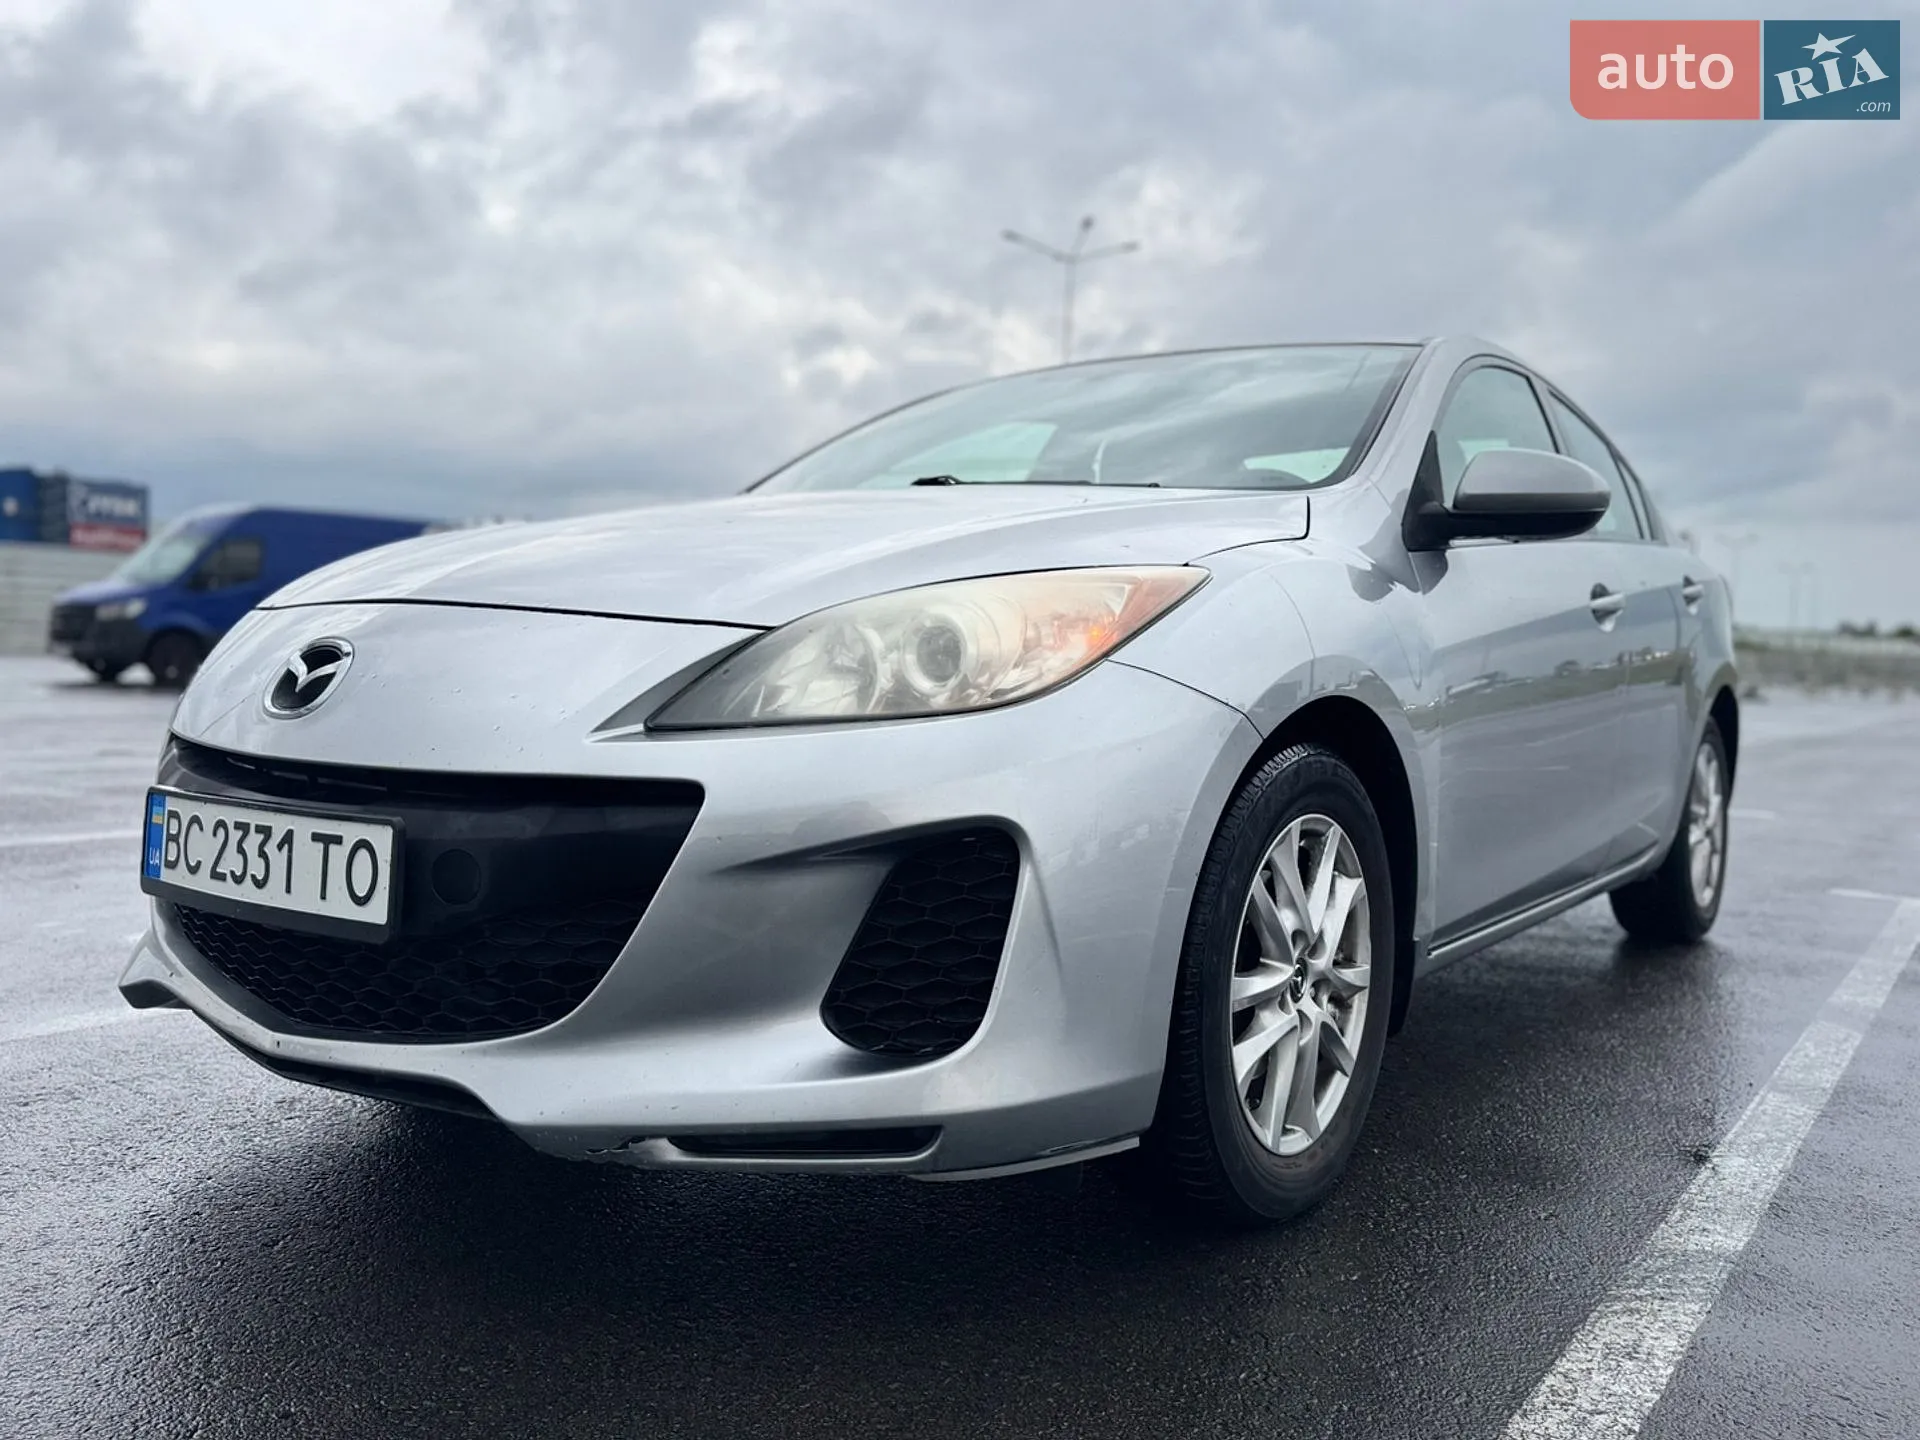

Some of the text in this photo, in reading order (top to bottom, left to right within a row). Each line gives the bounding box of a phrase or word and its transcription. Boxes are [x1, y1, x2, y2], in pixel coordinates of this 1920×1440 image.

[164, 810, 379, 906] BC 2331 TO
